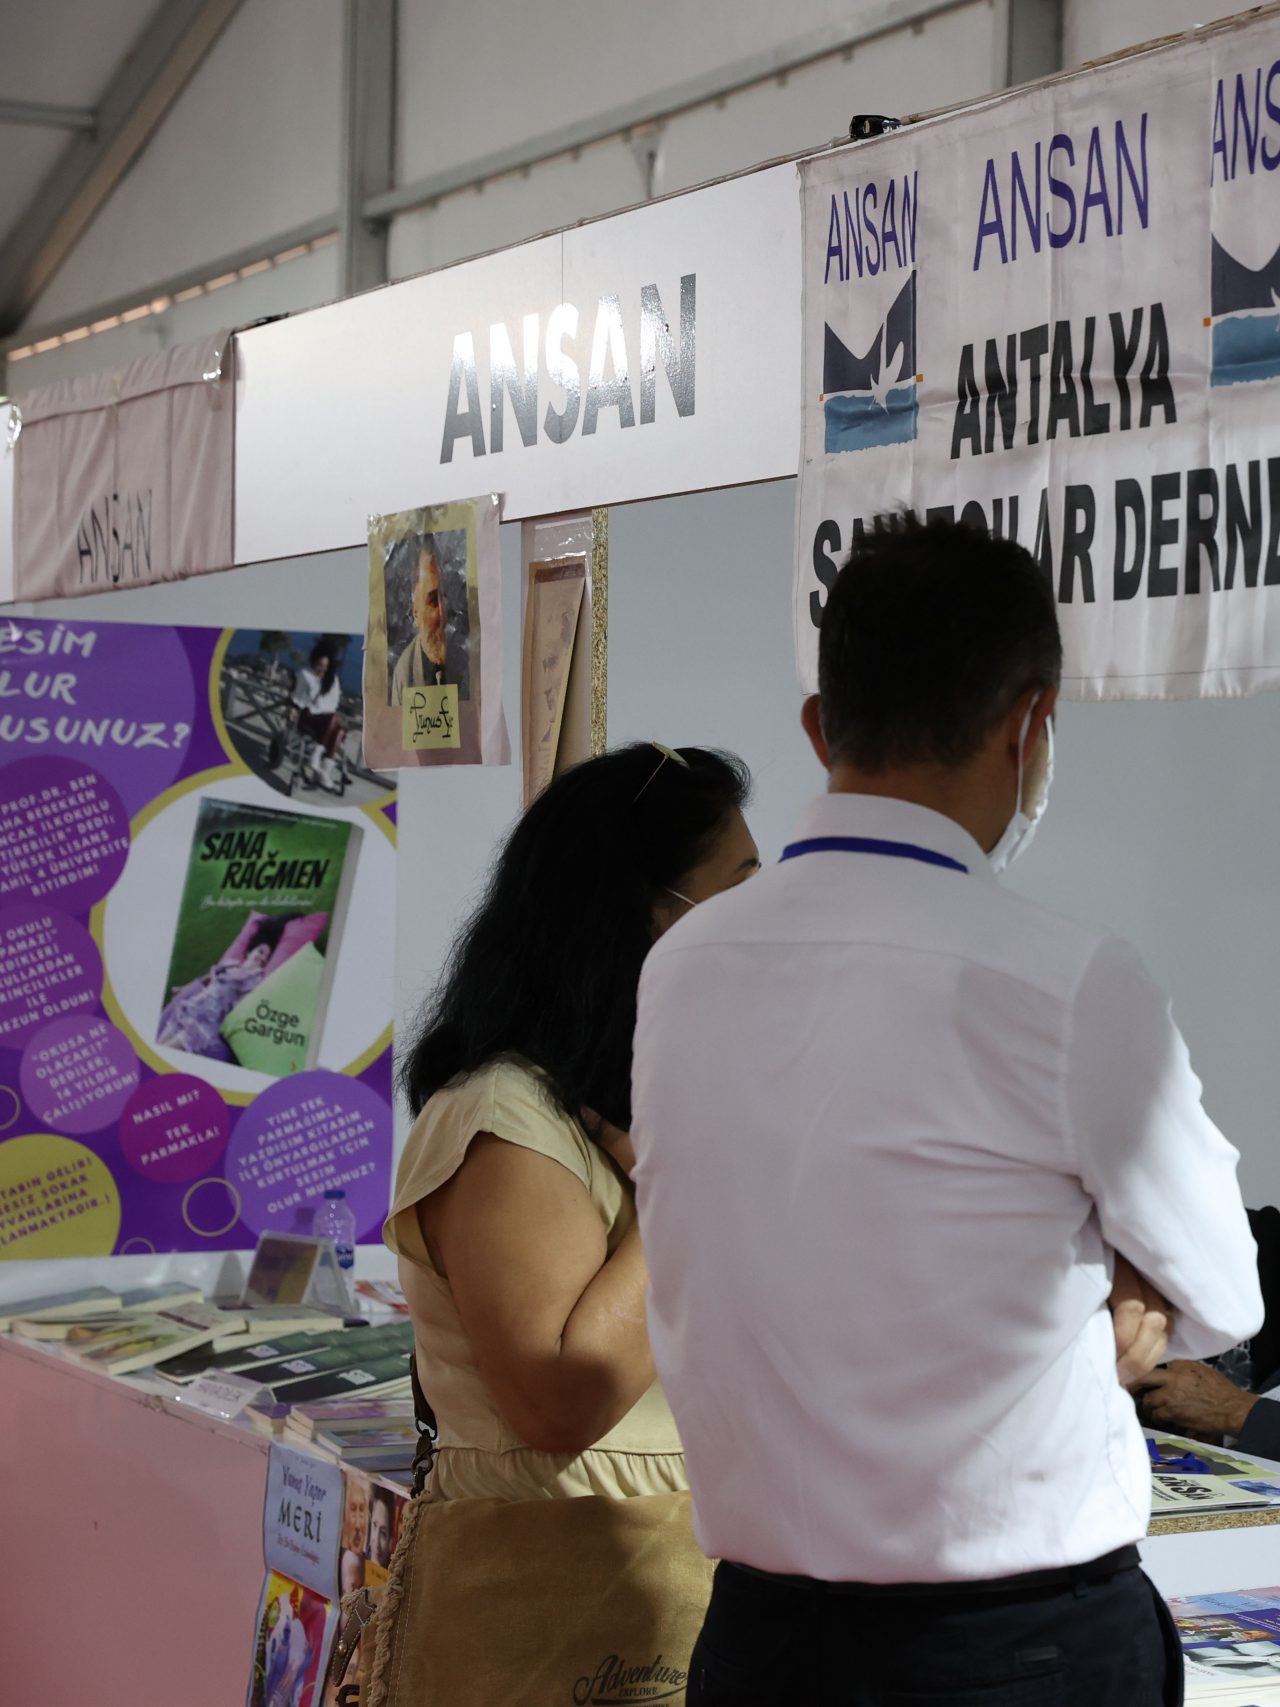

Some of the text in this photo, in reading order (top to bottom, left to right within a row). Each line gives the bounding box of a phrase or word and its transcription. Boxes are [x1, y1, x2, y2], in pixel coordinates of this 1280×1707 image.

[972, 112, 1149, 272] ANSAN
[824, 170, 918, 284] ANSAN
[439, 272, 697, 465] ANSAN
[950, 302, 1176, 459] ANTALYA
[77, 489, 153, 584] ANSAN
[69, 773, 97, 792] BEN
[200, 831, 268, 861] SANA
[221, 849, 331, 890] RAĞMEN
[256, 998, 300, 1029] Özge
[244, 1017, 305, 1047] Gargun
[132, 1101, 174, 1125] NASIL
[301, 1095, 326, 1113] TEK
[165, 1121, 191, 1141] TEK
[278, 1497, 322, 1543] MERİ
[573, 1654, 688, 1706] Adventure
[618, 1687, 658, 1697] EXPLORE
